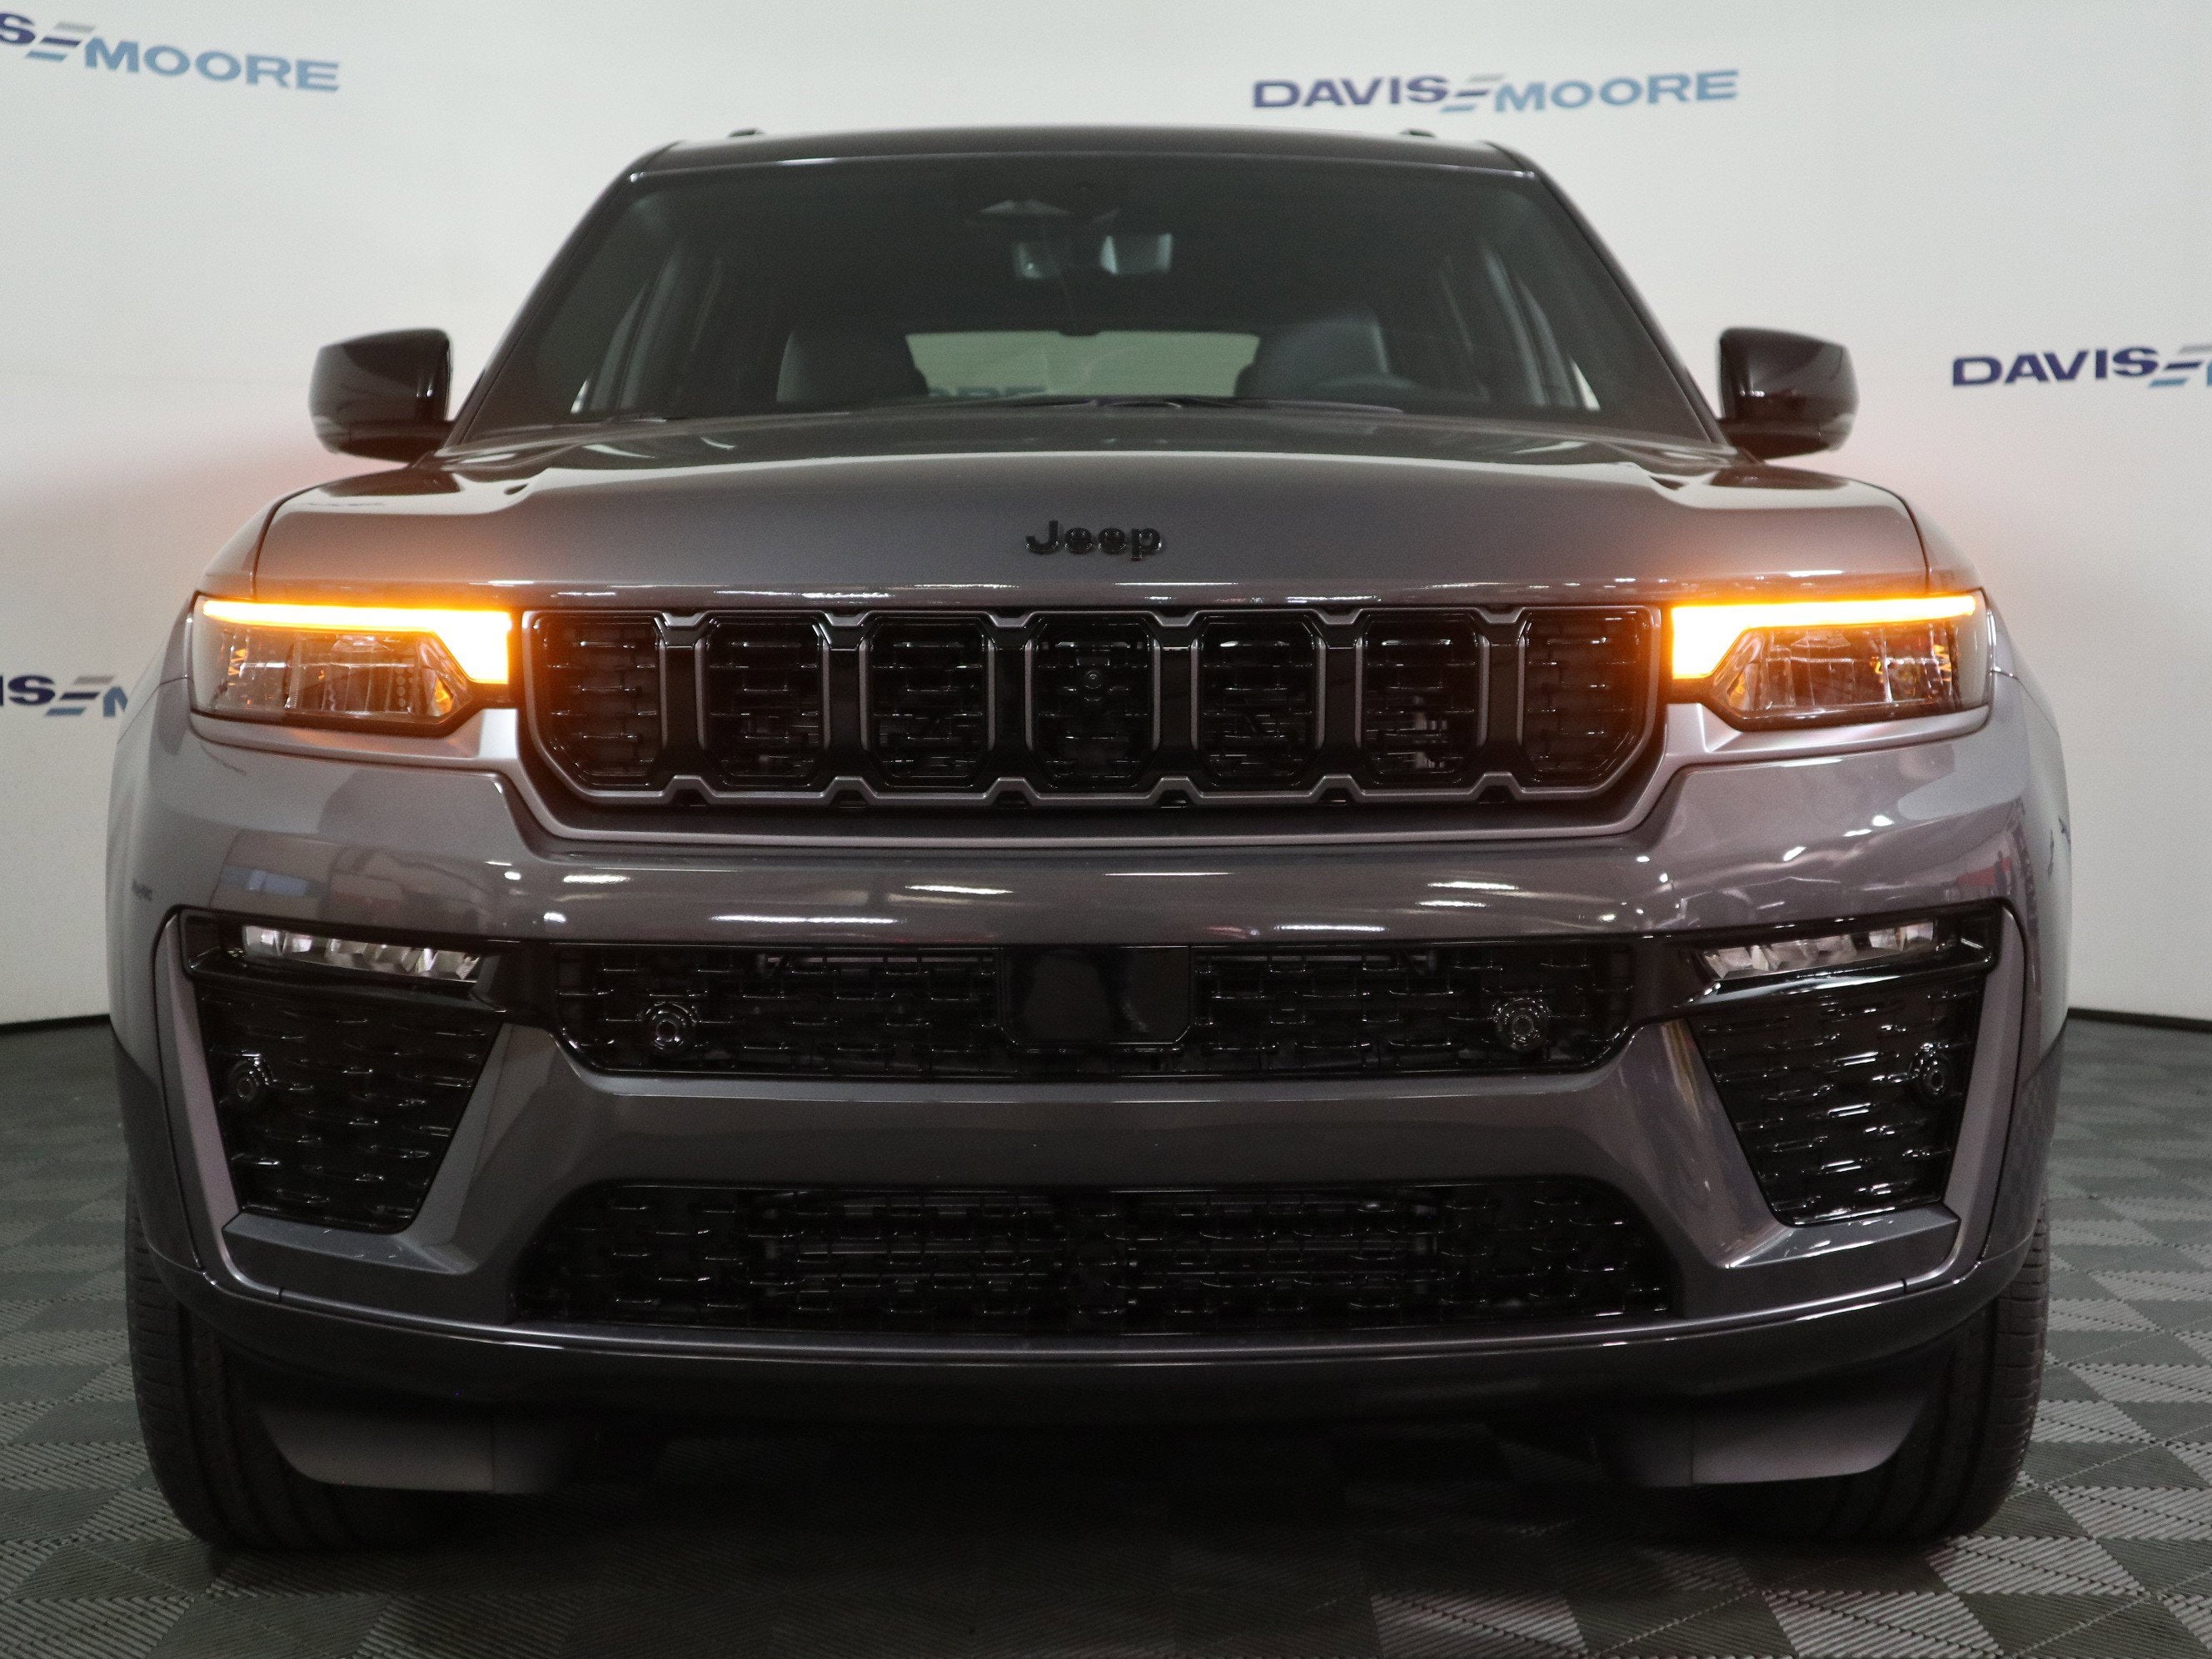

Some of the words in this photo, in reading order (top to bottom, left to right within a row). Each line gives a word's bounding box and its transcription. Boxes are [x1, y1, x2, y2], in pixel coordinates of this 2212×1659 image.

[84, 37, 339, 92] MOORE
[1253, 76, 1448, 108] DAVIS
[1495, 69, 1739, 112] MOORE
[1952, 346, 2160, 386] DAVIS
[1025, 520, 1163, 562] Jeep
